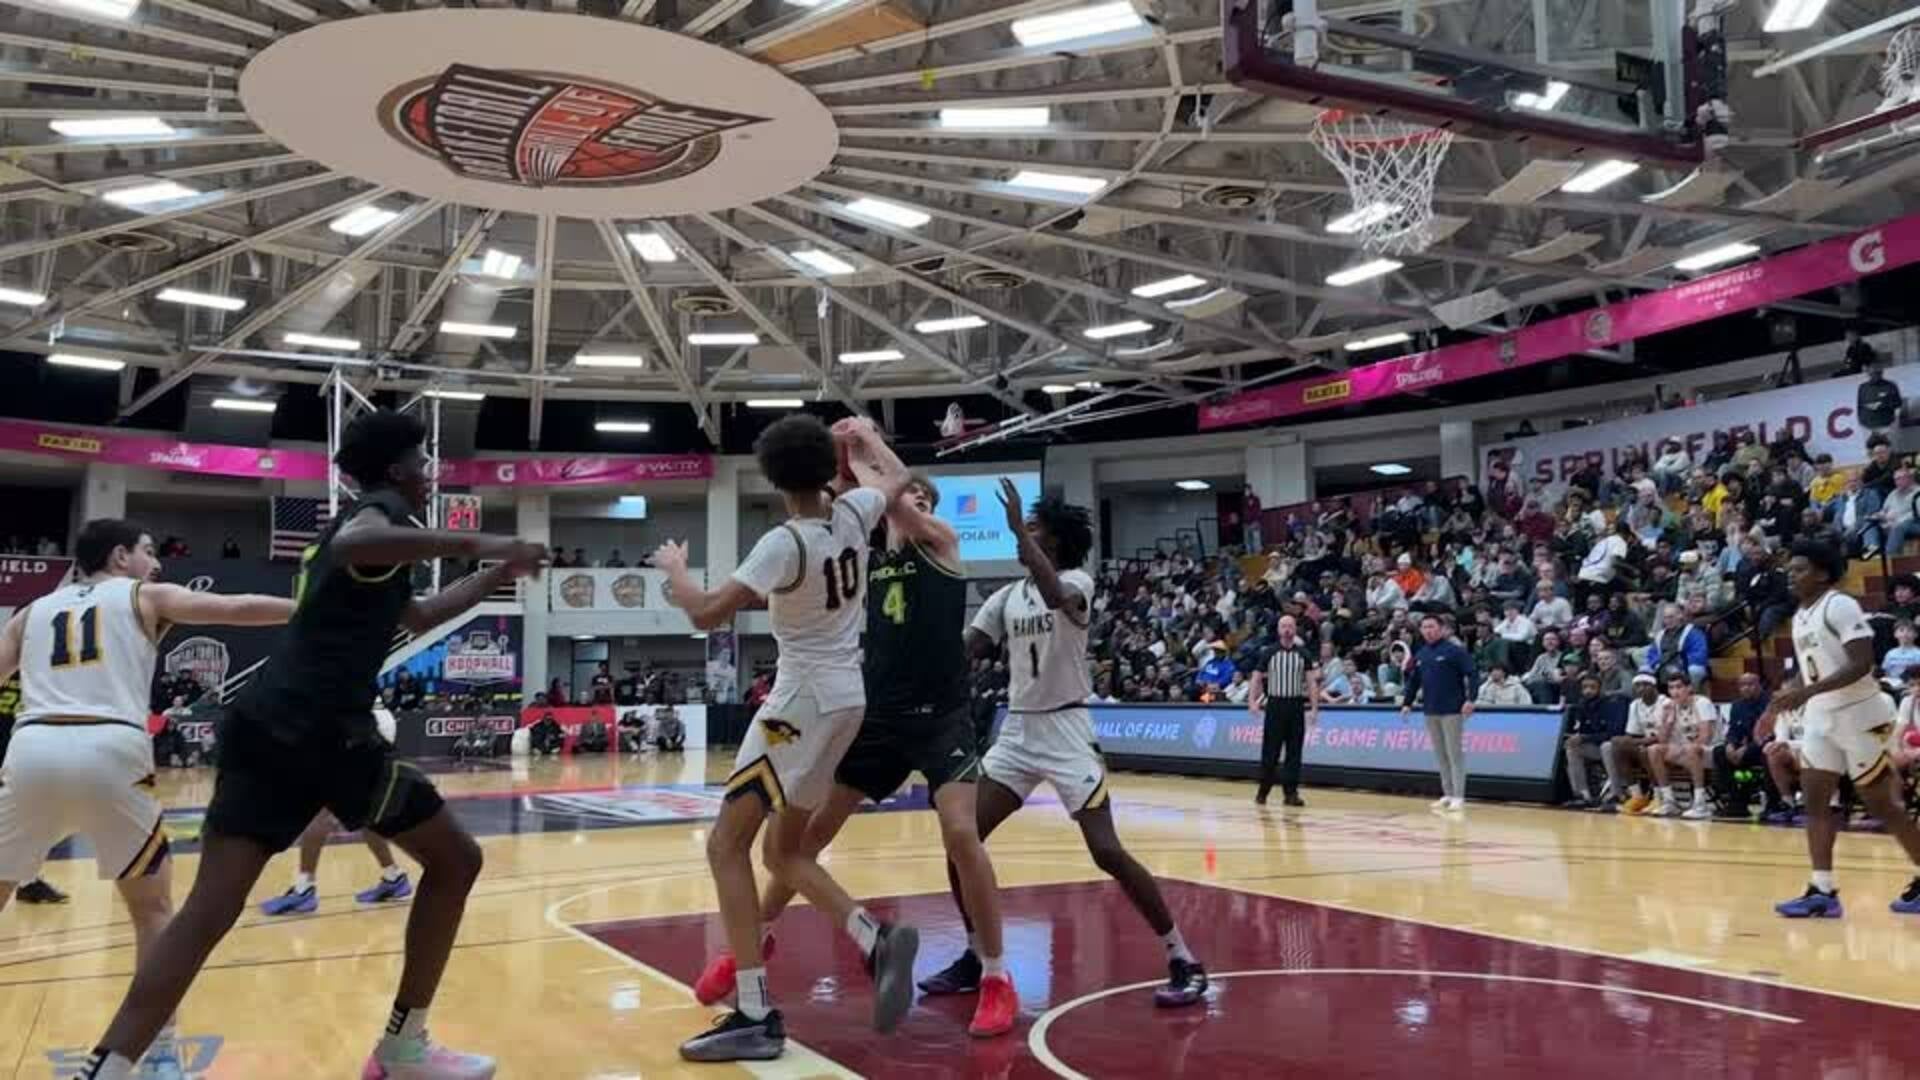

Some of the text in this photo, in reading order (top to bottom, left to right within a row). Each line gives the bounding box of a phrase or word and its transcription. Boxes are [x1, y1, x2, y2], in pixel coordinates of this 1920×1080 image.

[434, 73, 552, 178] BASKETBALL
[601, 106, 739, 151] FAME
[1850, 231, 1885, 272] G
[497, 463, 515, 482] G
[824, 546, 859, 610] 10
[882, 581, 906, 624] 4
[51, 605, 103, 667] 11
[1029, 641, 1040, 679] 1
[1806, 655, 1819, 682] 0
[1326, 728, 1377, 747] GAME
[1384, 730, 1433, 751] NEVE
